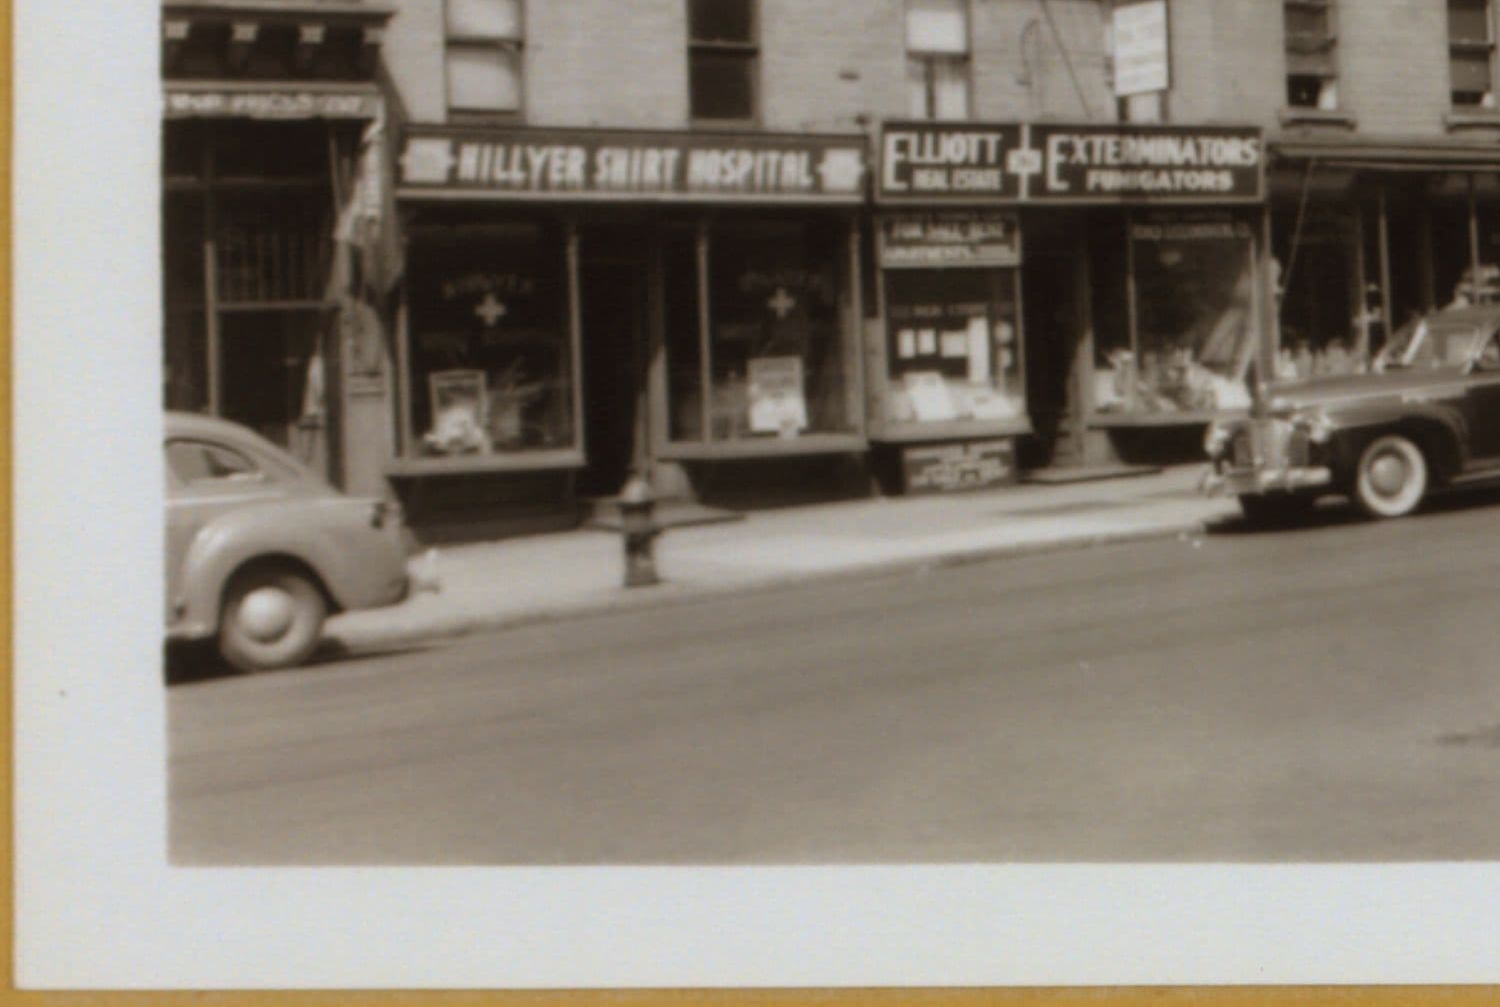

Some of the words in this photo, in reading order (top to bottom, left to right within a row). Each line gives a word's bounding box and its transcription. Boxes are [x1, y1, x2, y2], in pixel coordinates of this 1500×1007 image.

[458, 143, 586, 186] HILLYER
[595, 147, 679, 188] SHIRT
[688, 150, 813, 188] HOSPITAL
[885, 133, 1001, 189] ELLIOTT
[1046, 135, 1258, 190] EXTERMINATORS
[913, 169, 948, 189] REAL
[952, 169, 1001, 189] ESTATE
[1087, 171, 1233, 190] FUMIGATORS
